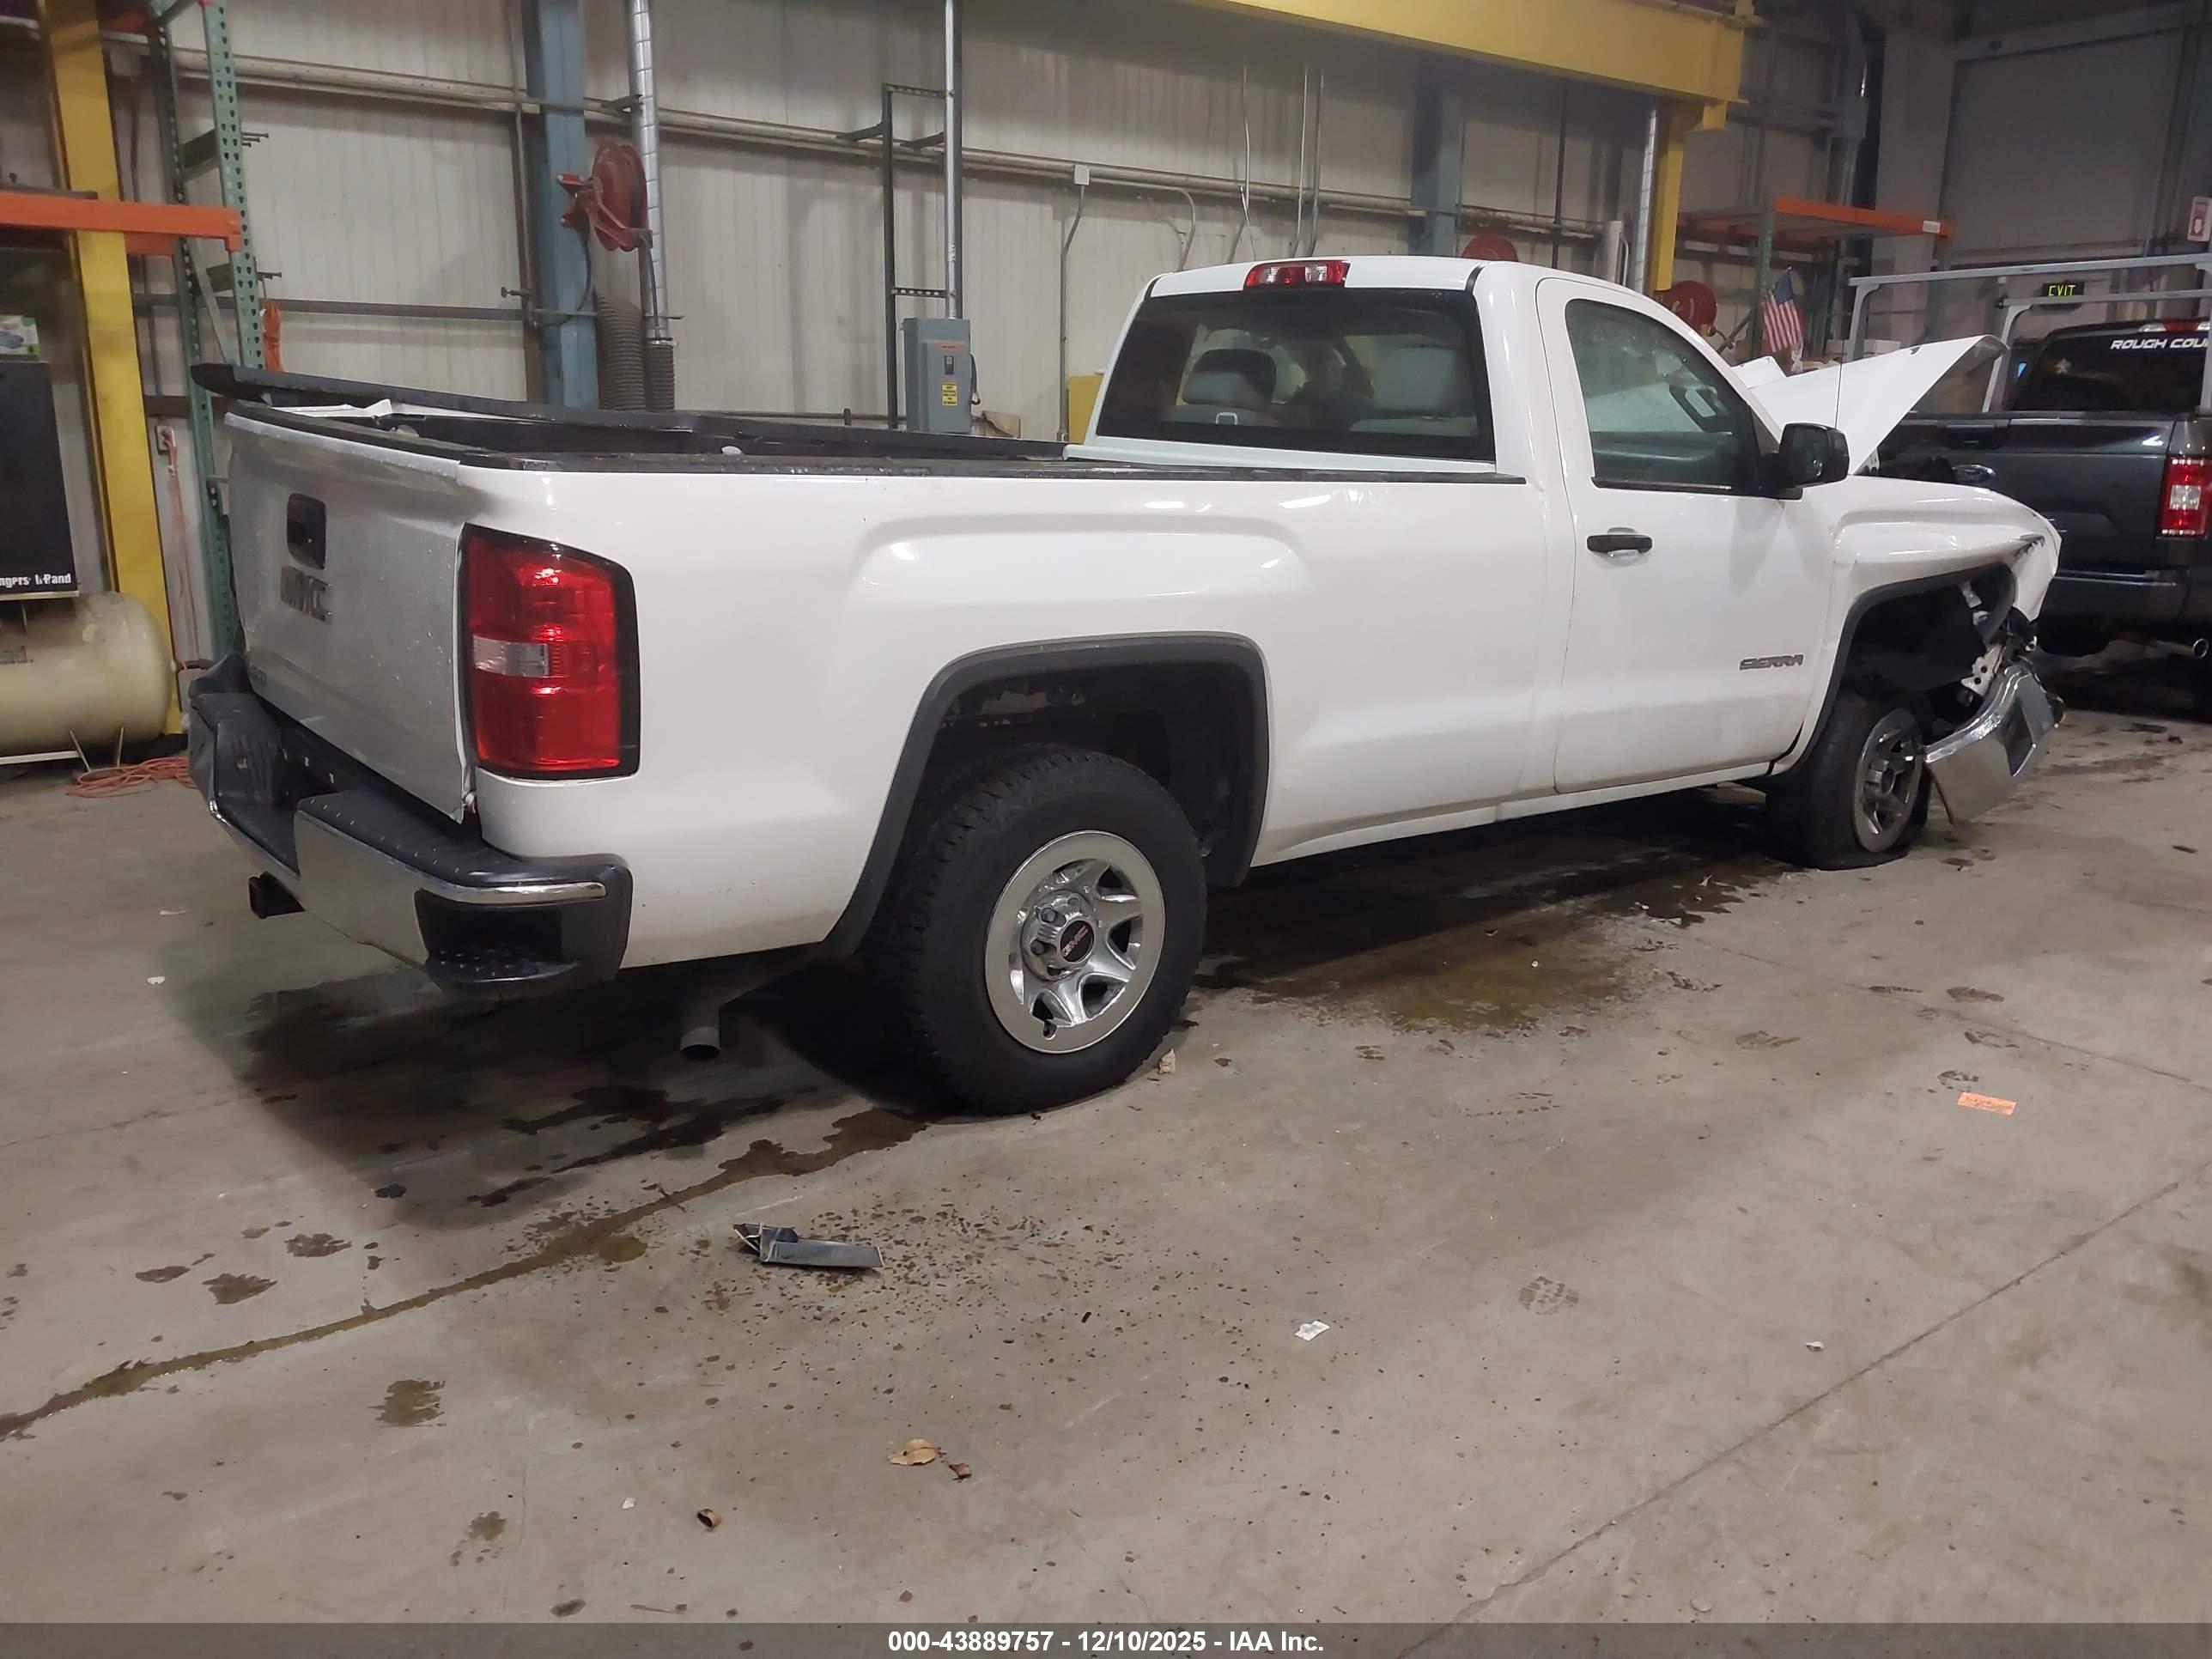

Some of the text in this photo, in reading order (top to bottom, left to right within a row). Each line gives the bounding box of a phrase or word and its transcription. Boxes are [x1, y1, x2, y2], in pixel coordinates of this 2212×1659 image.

[2110, 337, 2209, 349] ROUGH COU
[1060, 925, 1089, 957] GMC
